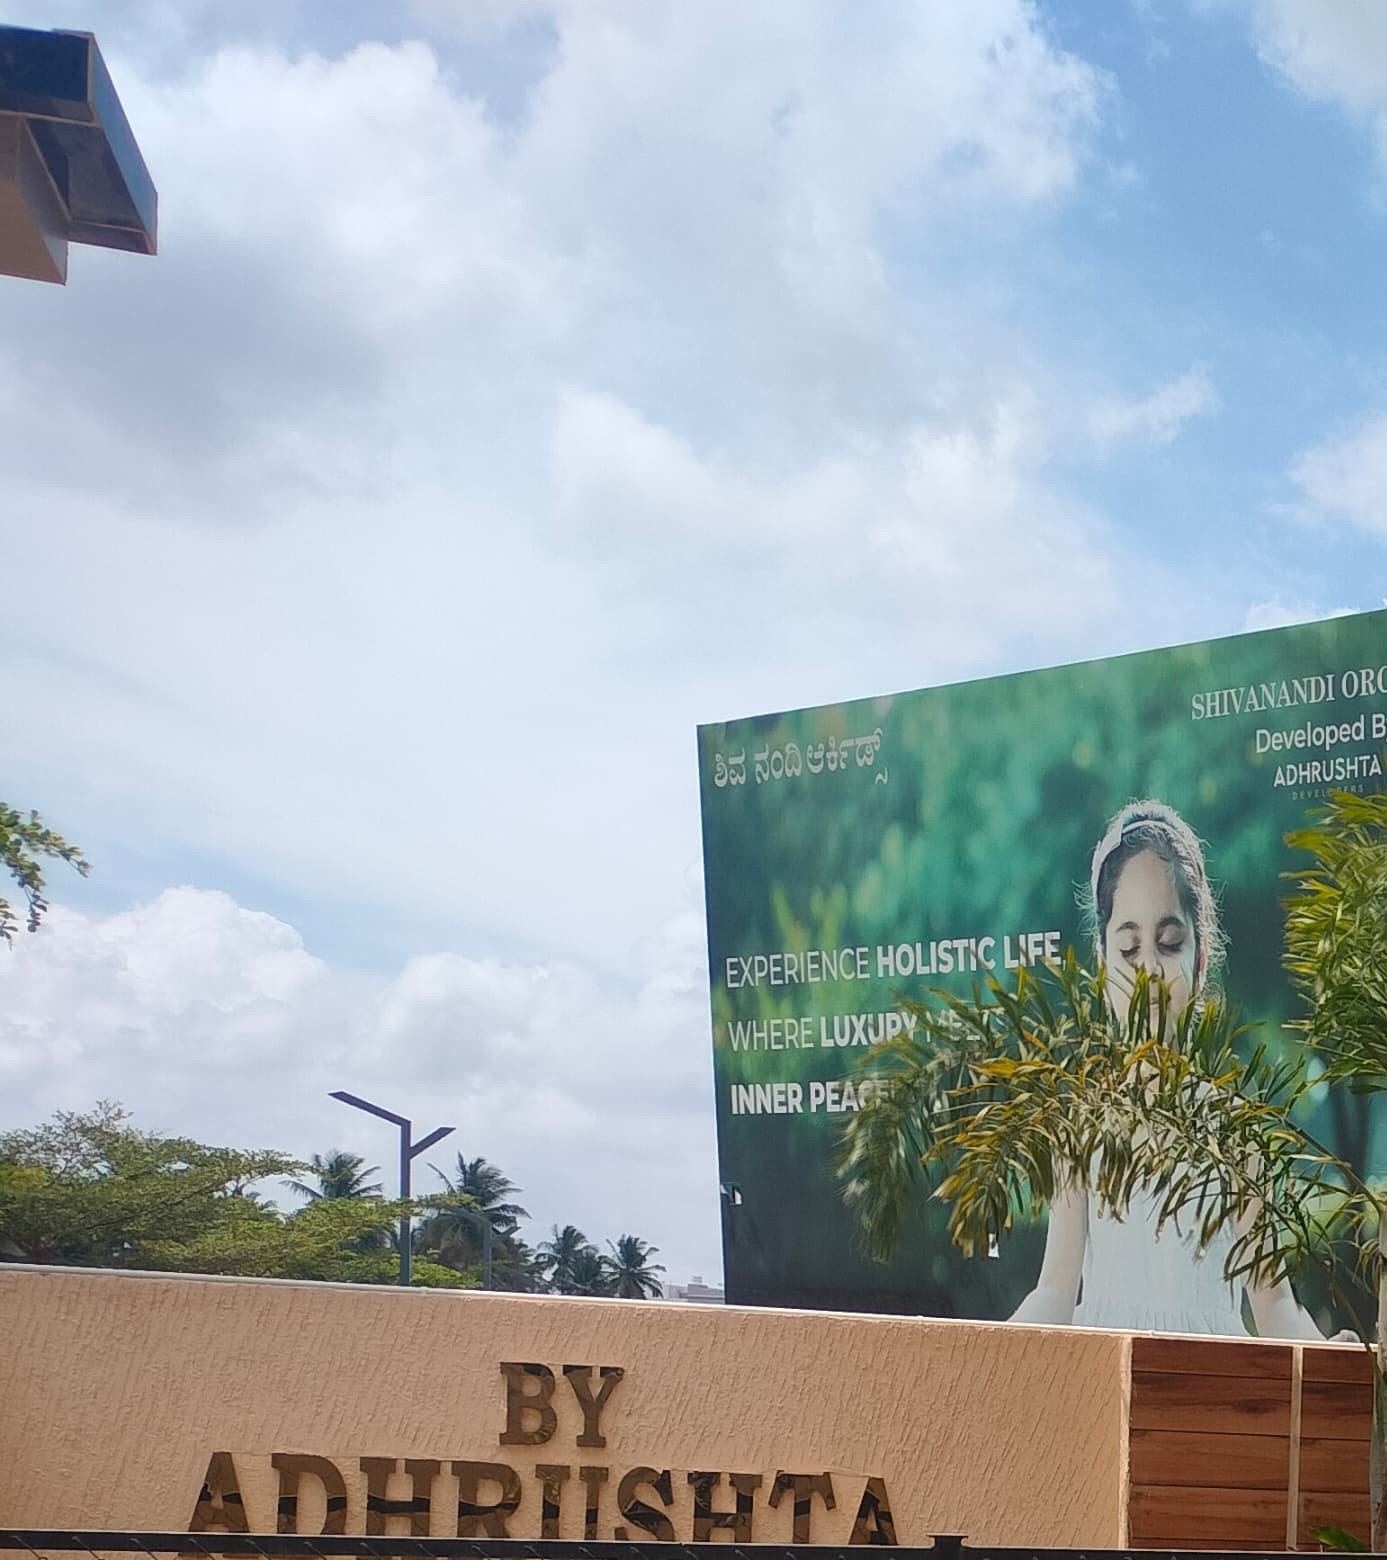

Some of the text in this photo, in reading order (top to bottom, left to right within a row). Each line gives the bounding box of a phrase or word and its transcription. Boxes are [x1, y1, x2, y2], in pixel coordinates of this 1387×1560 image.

[1191, 673, 1335, 721] SHIVANANDI
[1255, 713, 1365, 754] Developed
[714, 748, 746, 788] ಶಿವ
[755, 742, 802, 785] ನಂದಿ
[1273, 754, 1382, 788] ADHRUSHTA
[725, 946, 870, 989] EXPERIENCE
[877, 936, 996, 978] HOLISTIC
[728, 1017, 815, 1052] WHERE
[731, 1083, 804, 1115] INNER
[499, 1361, 625, 1448] BY
